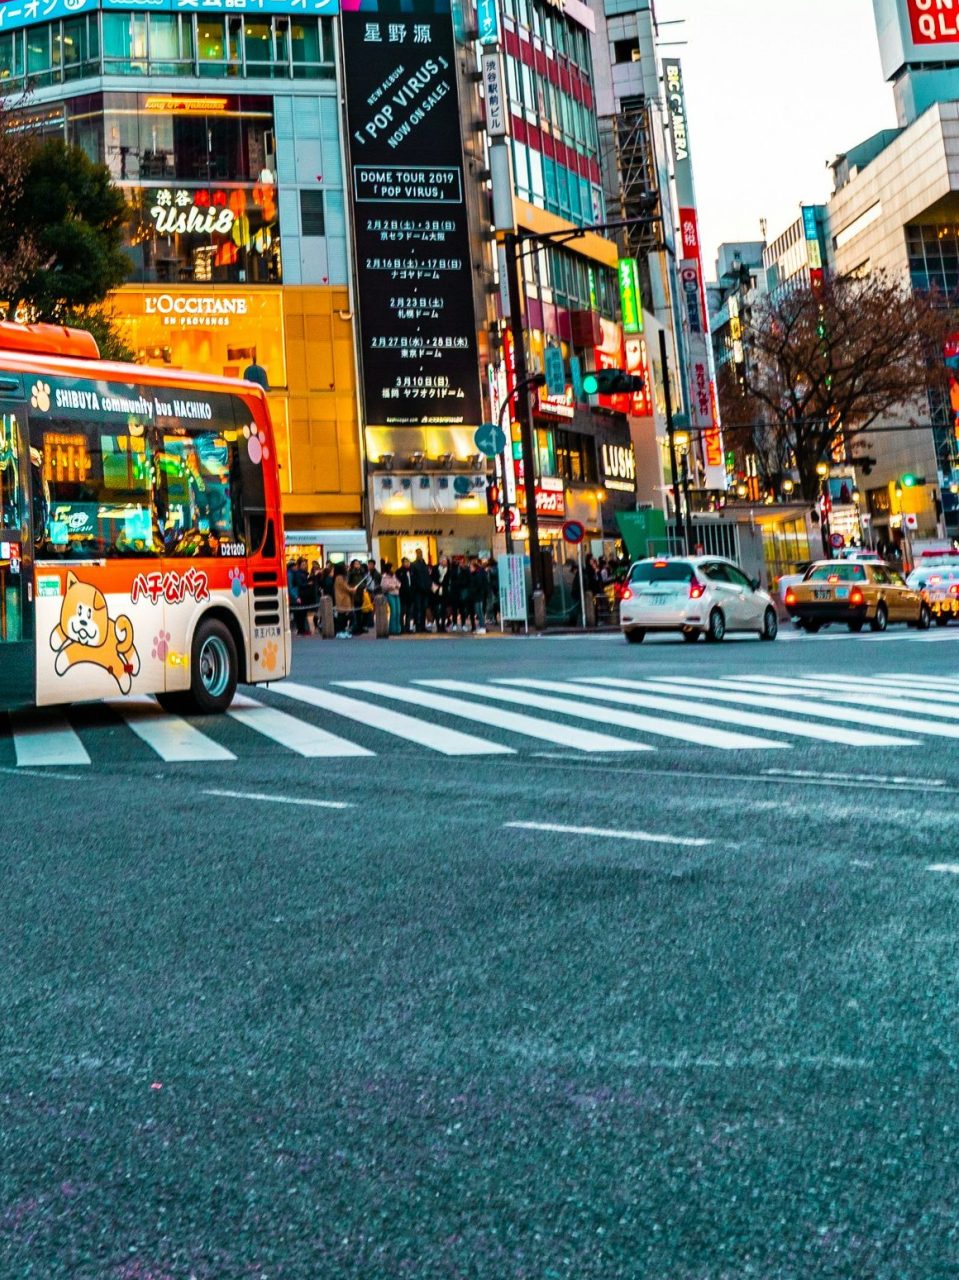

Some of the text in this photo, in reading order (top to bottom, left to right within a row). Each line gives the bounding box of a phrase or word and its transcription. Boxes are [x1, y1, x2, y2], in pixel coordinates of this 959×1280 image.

[364, 22, 432, 44] 星野源
[919, 13, 959, 40] QL
[366, 64, 406, 106] NEW ALBUM
[486, 60, 500, 129] 渋谷駅前ビル
[387, 80, 451, 148] NOW ON SALE!
[360, 171, 454, 184] DOME TOUR 2019
[150, 206, 235, 234] Ushi8
[683, 222, 697, 247] 免税
[391, 271, 440, 280] ナゴヤドーム
[390, 298, 444, 308] 2月23日(土)
[398, 309, 439, 319] 札幌ドーム
[164, 317, 230, 326] EN PROVENCE
[401, 349, 442, 359] 東京ドーム
[396, 377, 449, 387] 3月10日(日)
[56, 389, 212, 420] SHIBUYA community bus HACHIKO
[602, 444, 635, 480] LUSH
[221, 543, 246, 556] D21209
[131, 567, 210, 605] ハチ公バス
